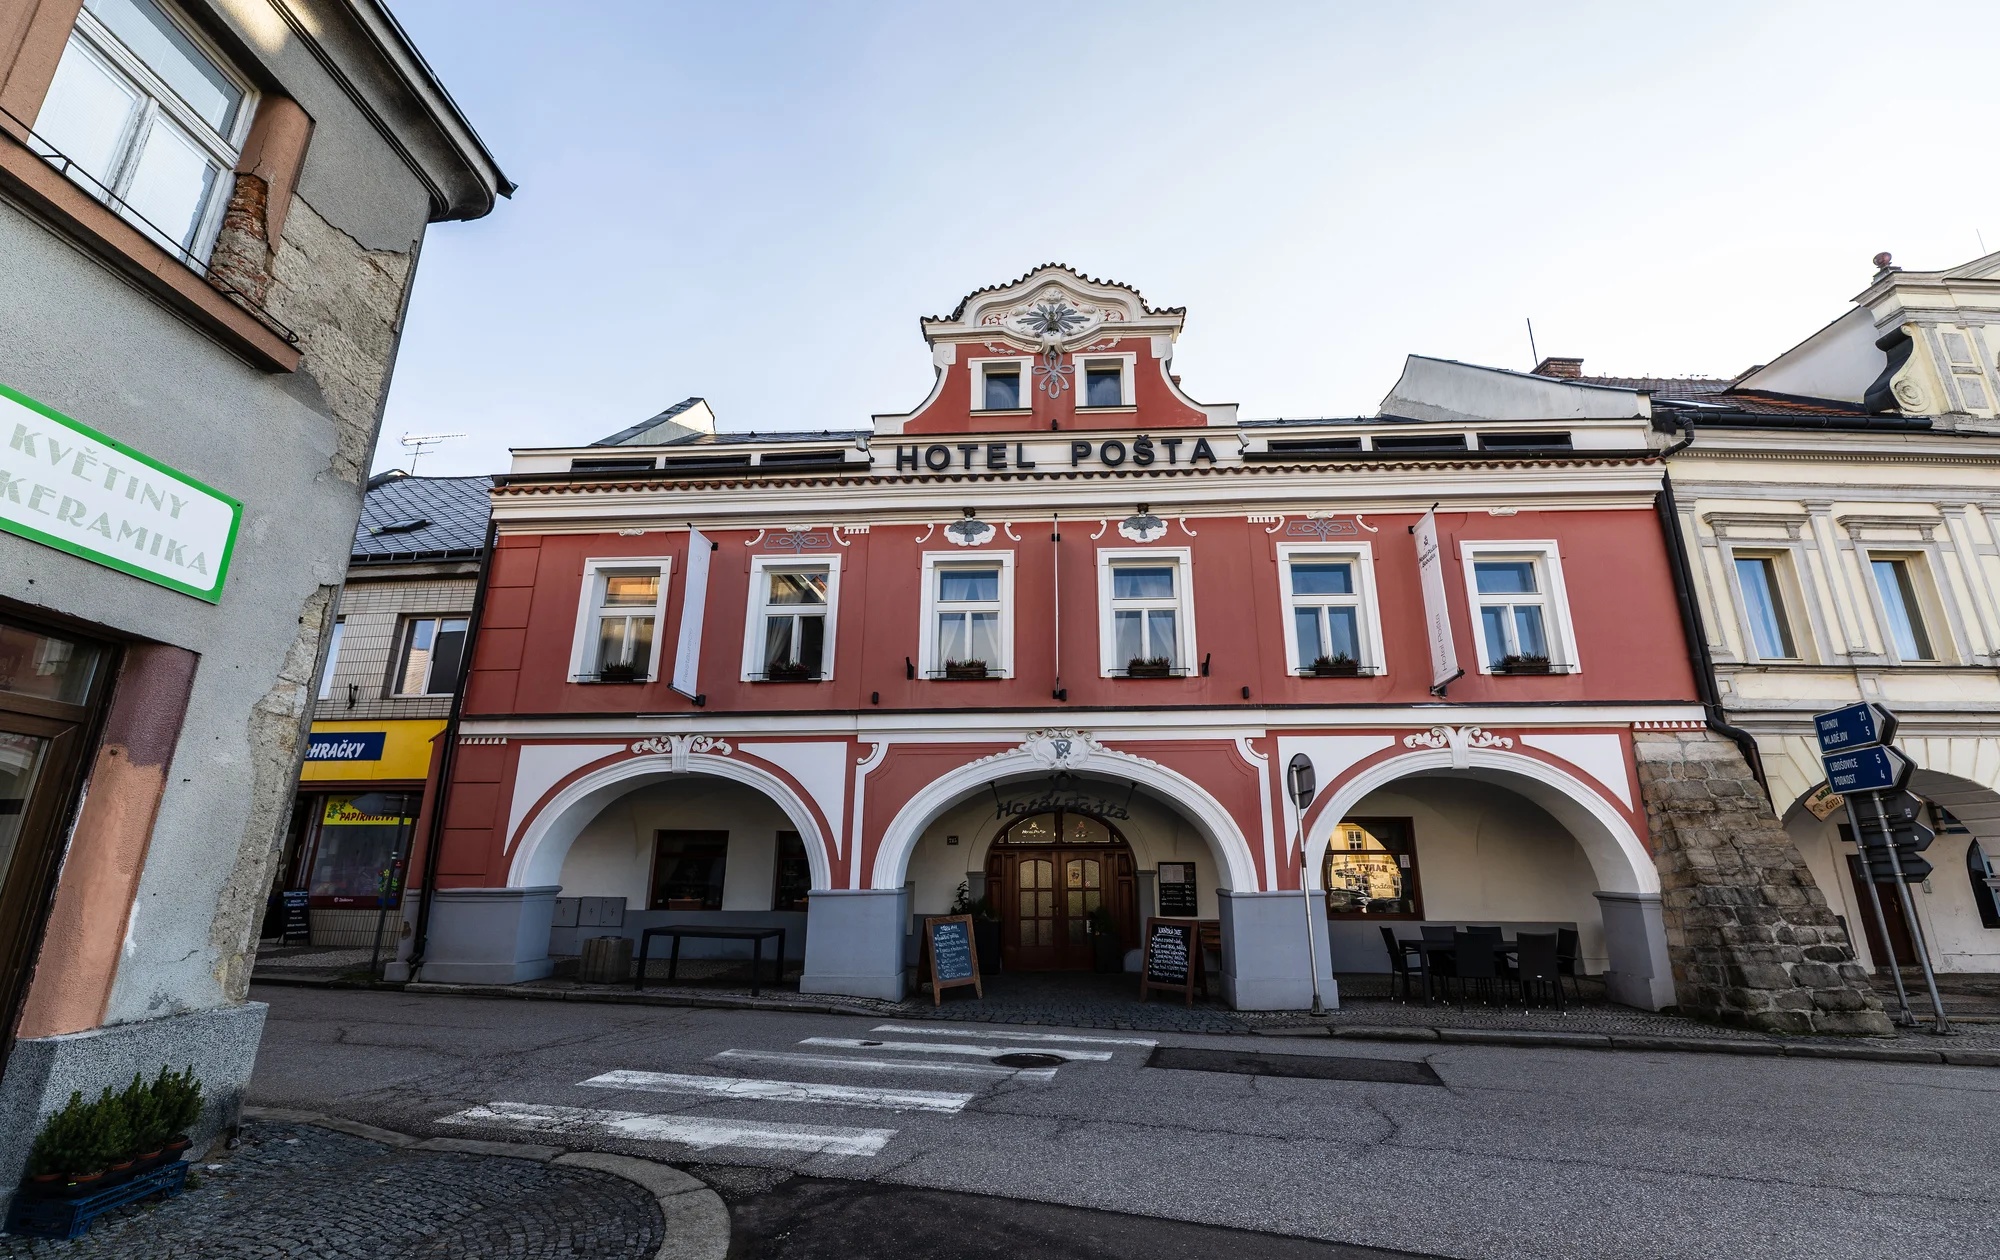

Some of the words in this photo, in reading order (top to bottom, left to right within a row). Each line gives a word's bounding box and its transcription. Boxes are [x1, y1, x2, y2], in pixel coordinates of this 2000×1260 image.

[896, 442, 1036, 471] HOTEL
[1071, 435, 1217, 467] POŠTA
[9, 423, 189, 520] KVĚTINY
[0, 469, 208, 576] KERAMIKA
[1821, 718, 1838, 731] TURNOV
[1859, 712, 1866, 722] 21
[1865, 726, 1870, 736] 5
[309, 739, 366, 759] HRAČKY
[1830, 758, 1858, 772] LIBOŠOVICE
[1875, 754, 1881, 764] 5
[1834, 774, 1856, 786] PODKOST
[1880, 770, 1885, 779] 4
[996, 796, 1060, 820] Hotel
[1063, 796, 1130, 820] Pošta
